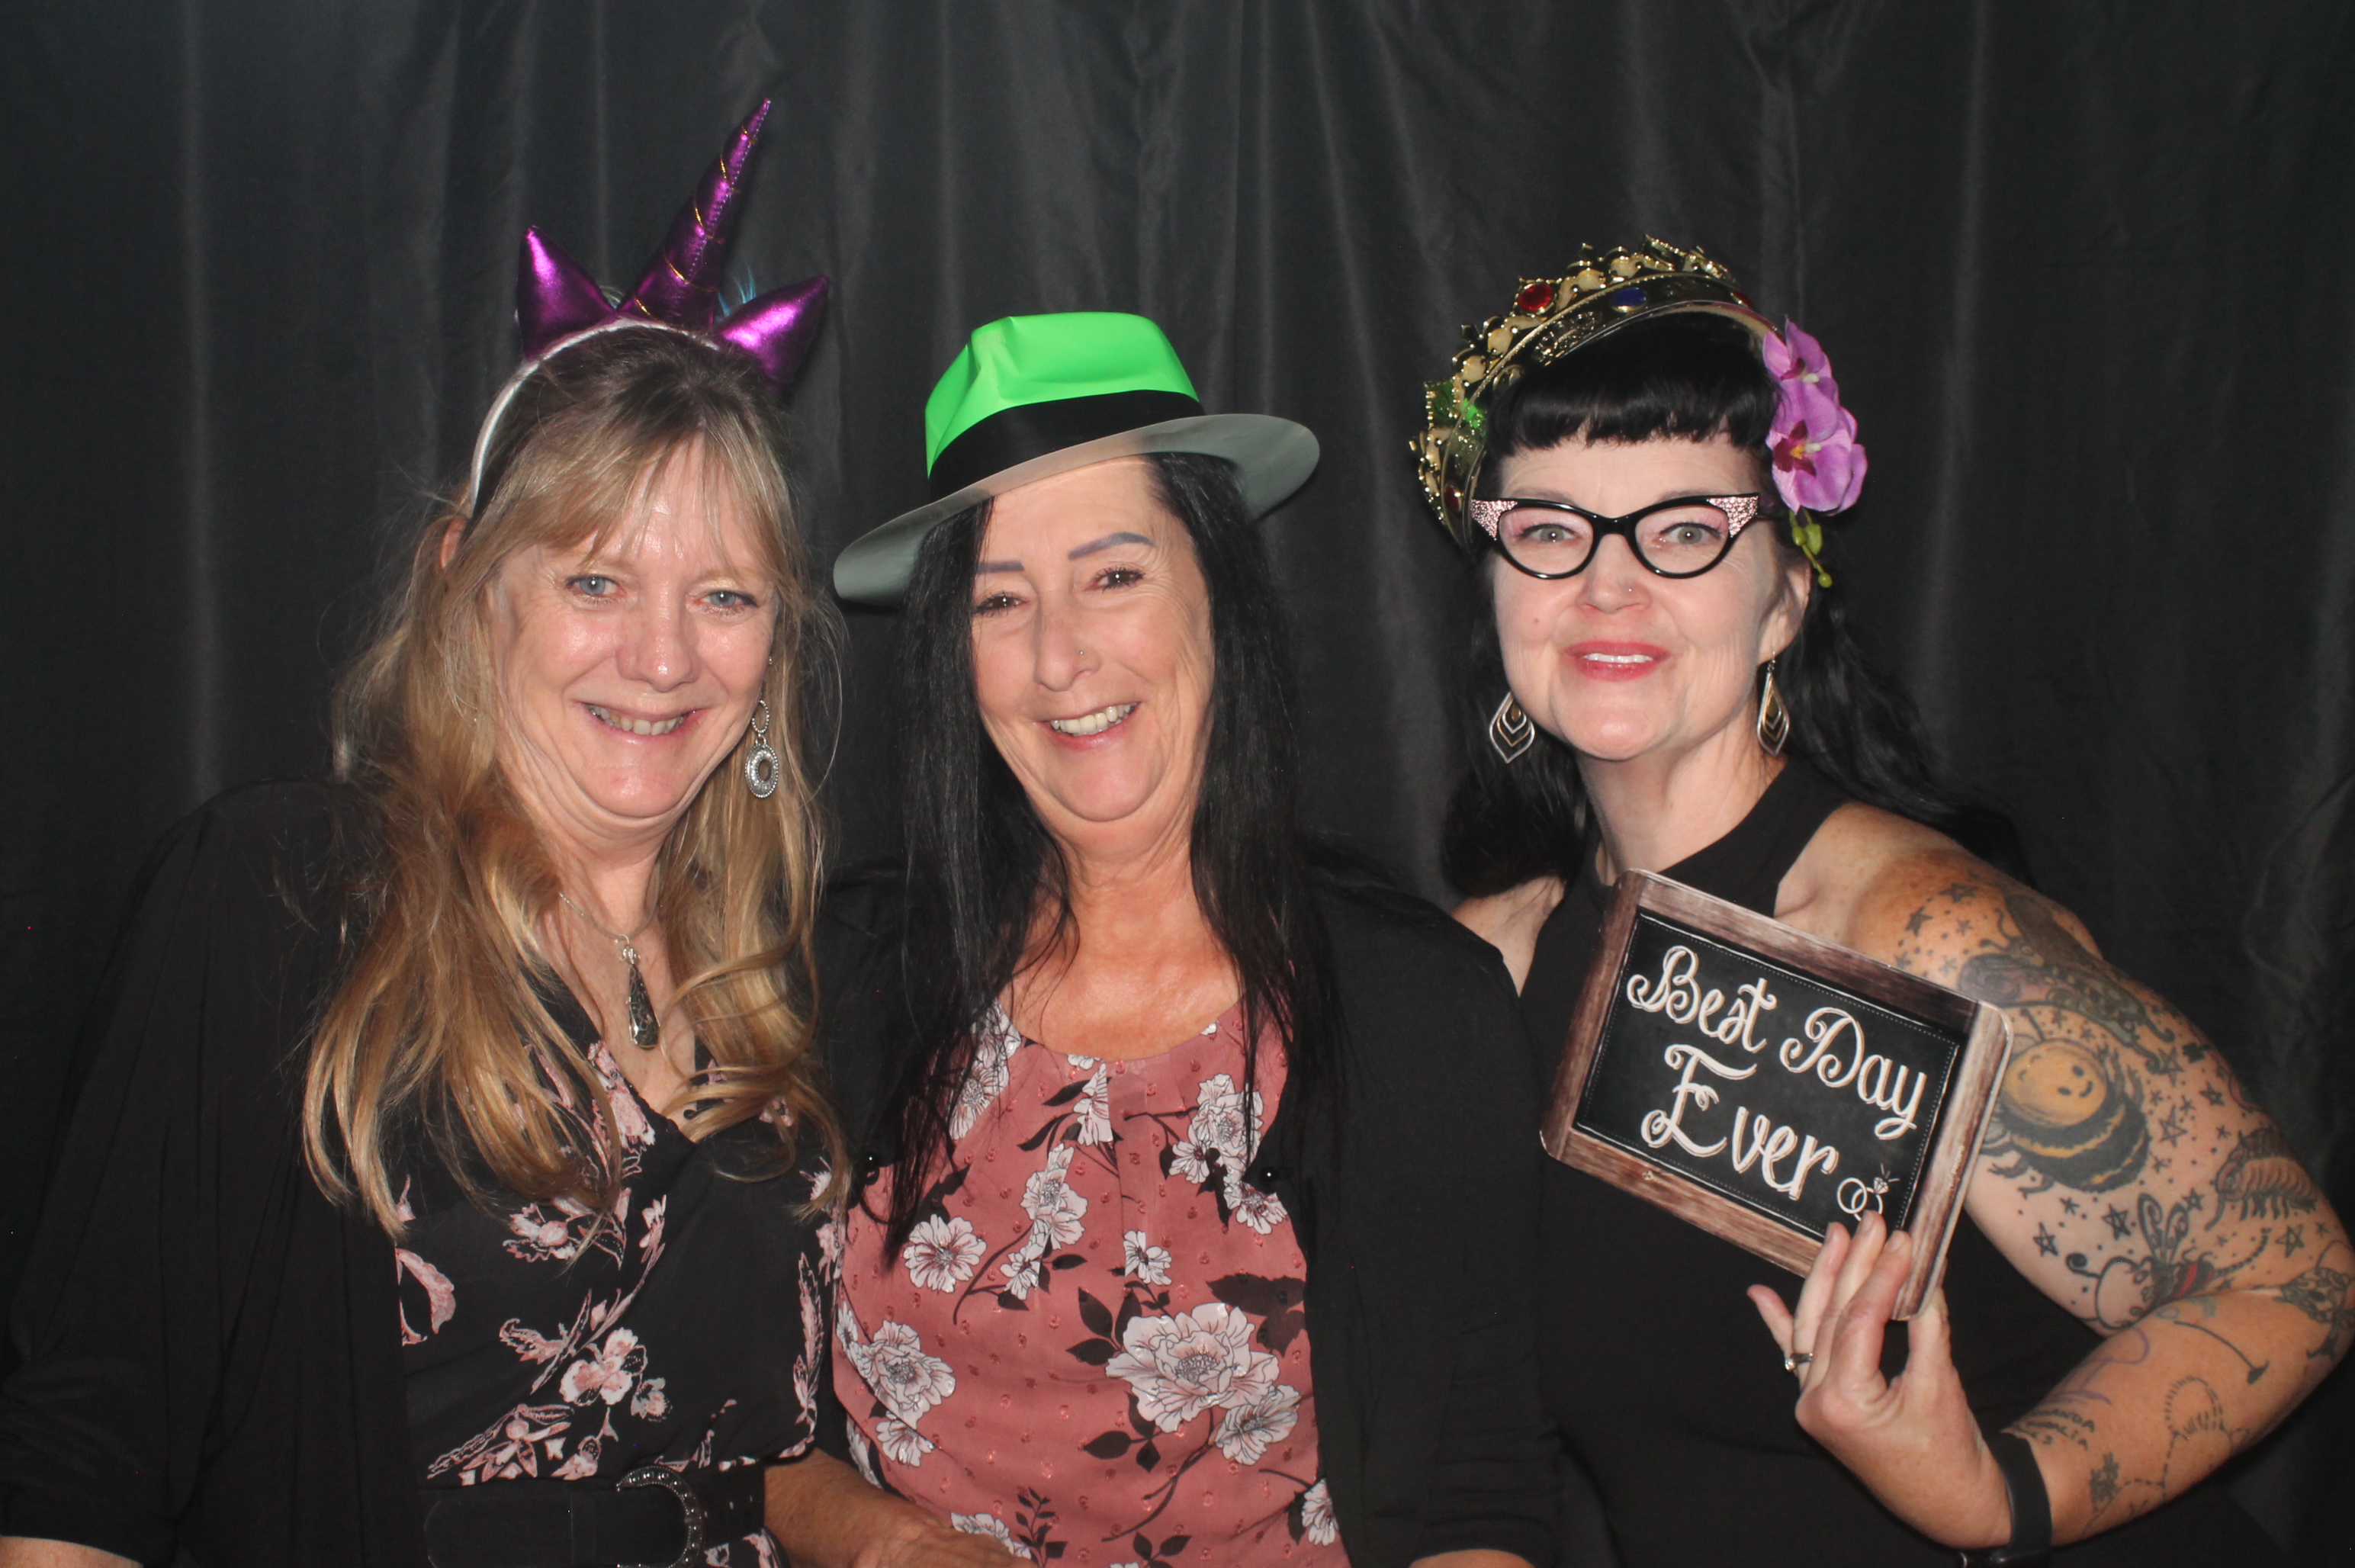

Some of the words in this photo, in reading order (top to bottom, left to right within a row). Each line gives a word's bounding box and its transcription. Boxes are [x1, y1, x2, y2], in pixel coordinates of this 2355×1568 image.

[1627, 945, 1778, 1053] Best
[1779, 1007, 1927, 1140] Day
[1641, 1044, 1839, 1201] Ever
